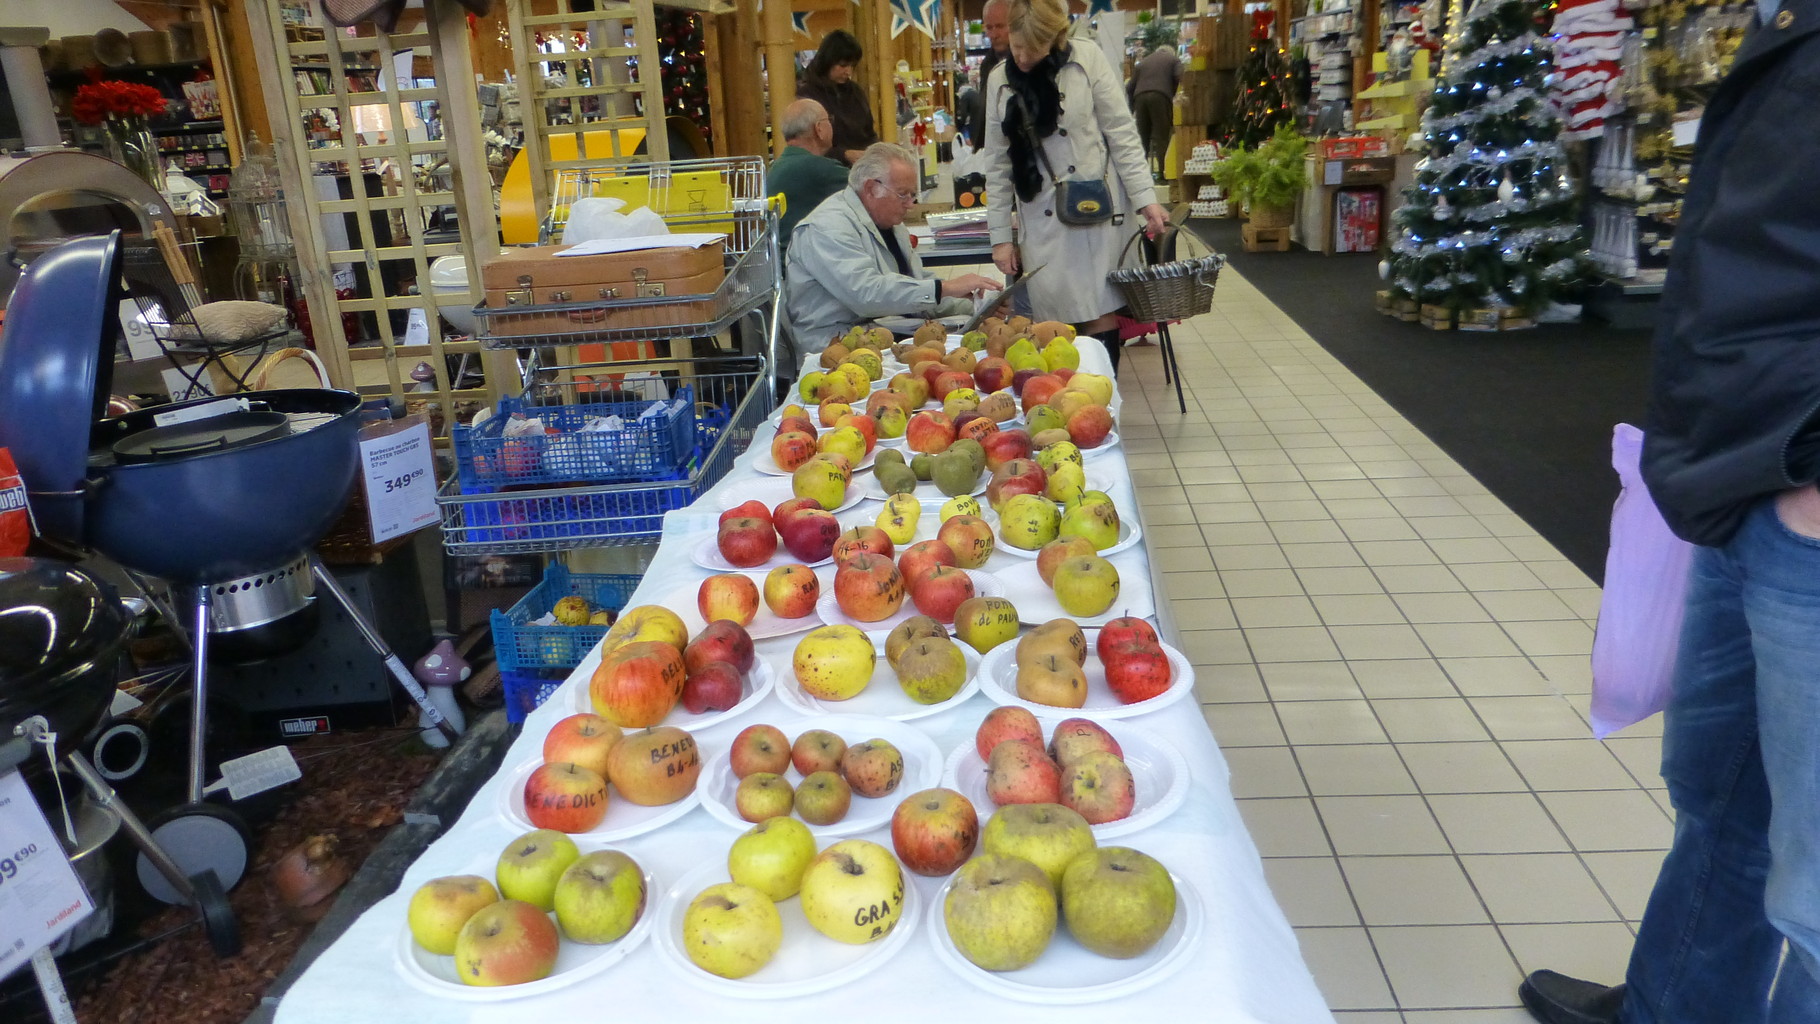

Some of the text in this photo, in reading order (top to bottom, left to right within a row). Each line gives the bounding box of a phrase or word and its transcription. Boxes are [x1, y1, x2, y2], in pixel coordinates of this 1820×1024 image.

[369, 445, 395, 456] Barbecue
[370, 451, 393, 462] MASTER
[393, 447, 410, 456] TOUCH
[284, 718, 317, 733] weber
